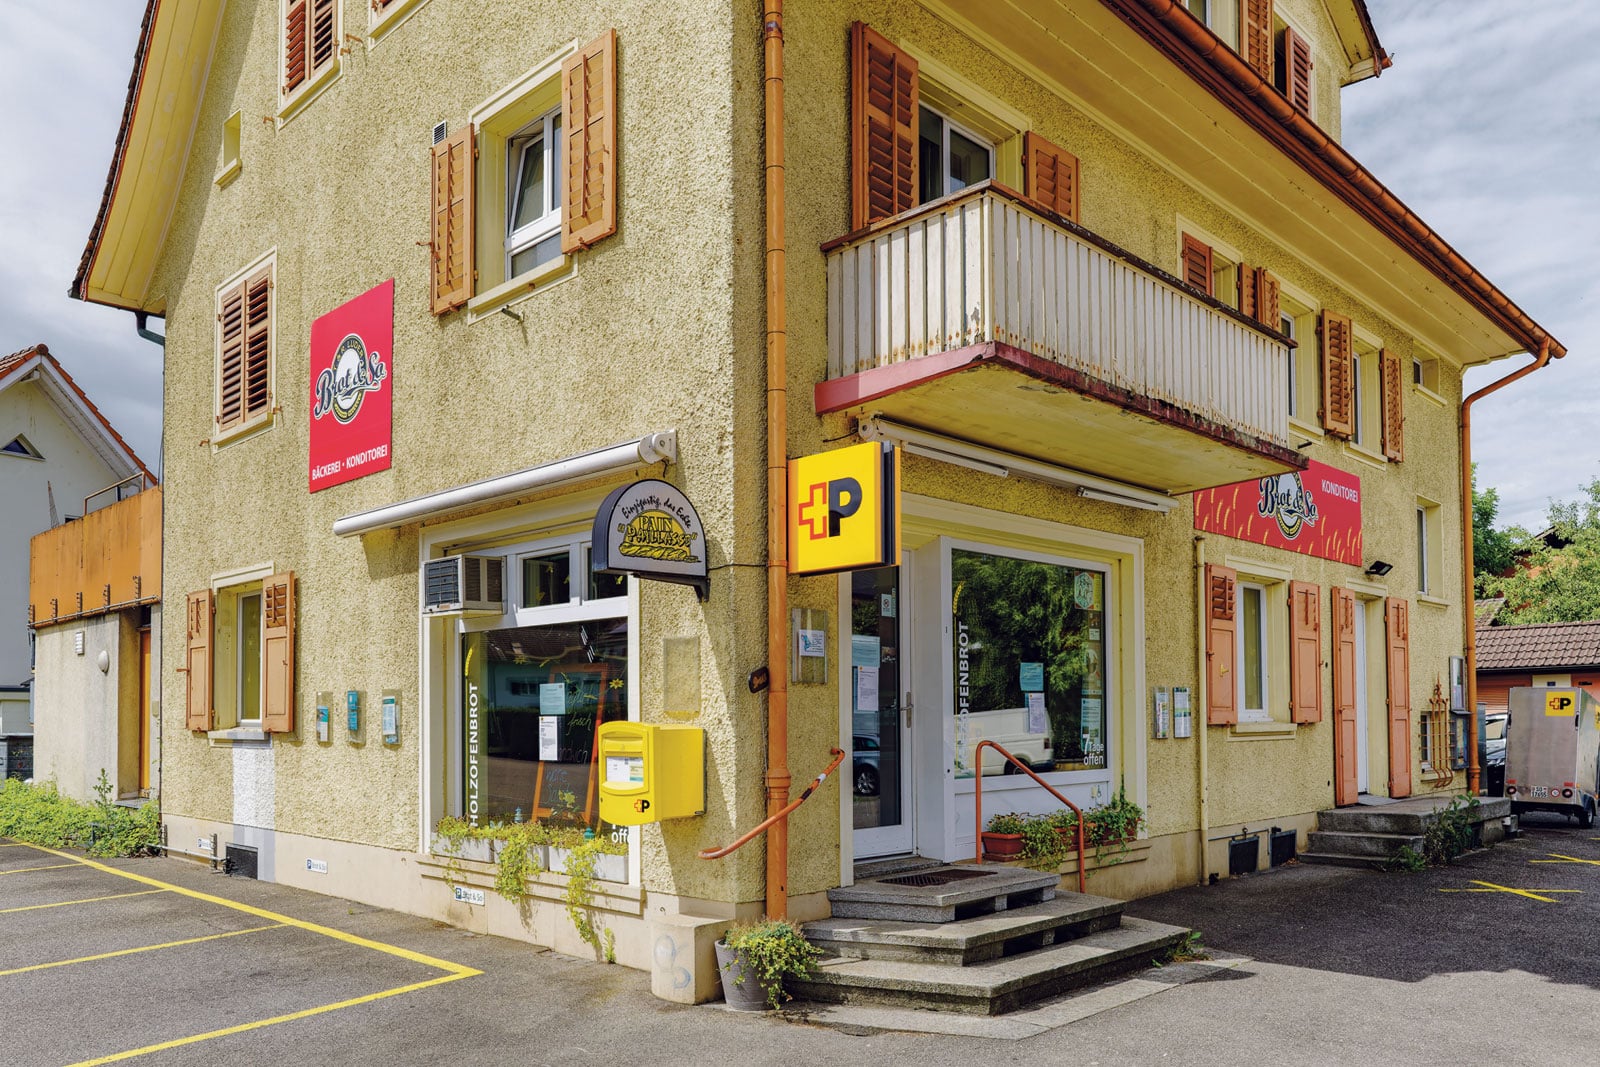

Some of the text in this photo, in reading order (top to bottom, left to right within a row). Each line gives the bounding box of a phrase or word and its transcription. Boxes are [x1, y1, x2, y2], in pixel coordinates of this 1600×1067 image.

[314, 367, 351, 418] Brot
[366, 350, 387, 386] So
[311, 444, 388, 481] BÄCKEREI KONDITOREI
[1258, 474, 1292, 514] Brot
[1304, 490, 1318, 518] So
[1321, 479, 1359, 503] KONDITOREI
[664, 498, 676, 512] das
[828, 477, 863, 538] P
[638, 515, 673, 532] PAIN
[1559, 697, 1572, 710] P
[1082, 733, 1105, 754] 7 Tage
[469, 683, 479, 827] HOLZOFENBROT
[1083, 753, 1104, 767] offen
[641, 800, 650, 813] P
[611, 828, 629, 844] off
